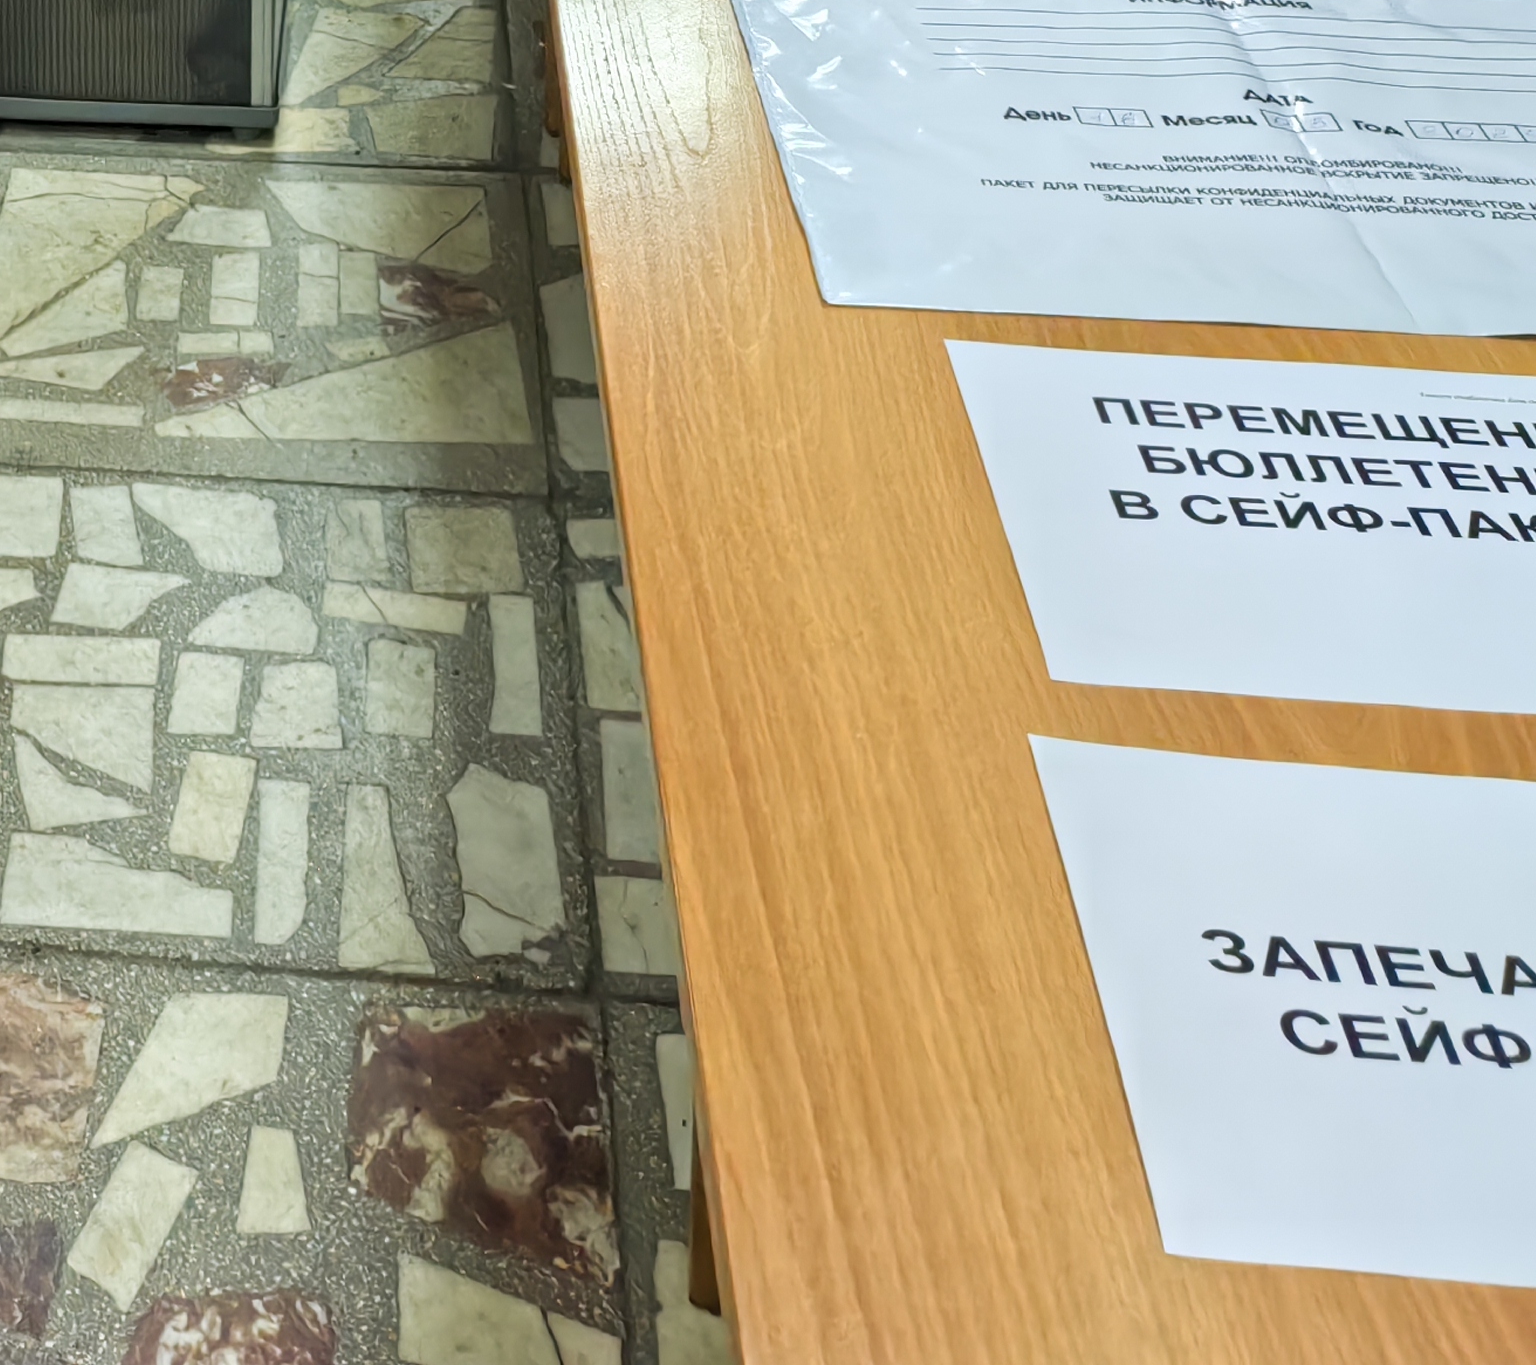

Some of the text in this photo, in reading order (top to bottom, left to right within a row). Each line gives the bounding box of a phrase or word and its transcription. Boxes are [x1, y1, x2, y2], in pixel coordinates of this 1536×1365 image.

[1003, 107, 1072, 122] День
[1161, 114, 1258, 127] Месяц
[1352, 120, 1404, 137] Год
[1321, 170, 1415, 181] ВСКРЫТИЕ
[980, 178, 1035, 189] ПАКЕТ
[1043, 180, 1079, 191] ДЛЯ
[1083, 183, 1192, 195] ПЕРЕСЫЛКИ
[1196, 186, 1396, 204] КОНФИДЕНЦИАЛЬНЫХ
[1402, 195, 1526, 210] ДОКУМЕНТОВ
[1103, 193, 1204, 205] ЗАЩИЩАЕТ
[1210, 197, 1235, 207] ОТ
[1240, 197, 1486, 219] НЕСАНКЦИОНИРОВАННОГО
[1092, 396, 1536, 449] ПЕРЕМЕЩЕН
[1137, 444, 1536, 495] БЮЛЛЕТЕН
[1109, 489, 1159, 520] В
[1201, 928, 1536, 997] ЗАПЕЧА
[1280, 1004, 1532, 1070] СЕЙФ
